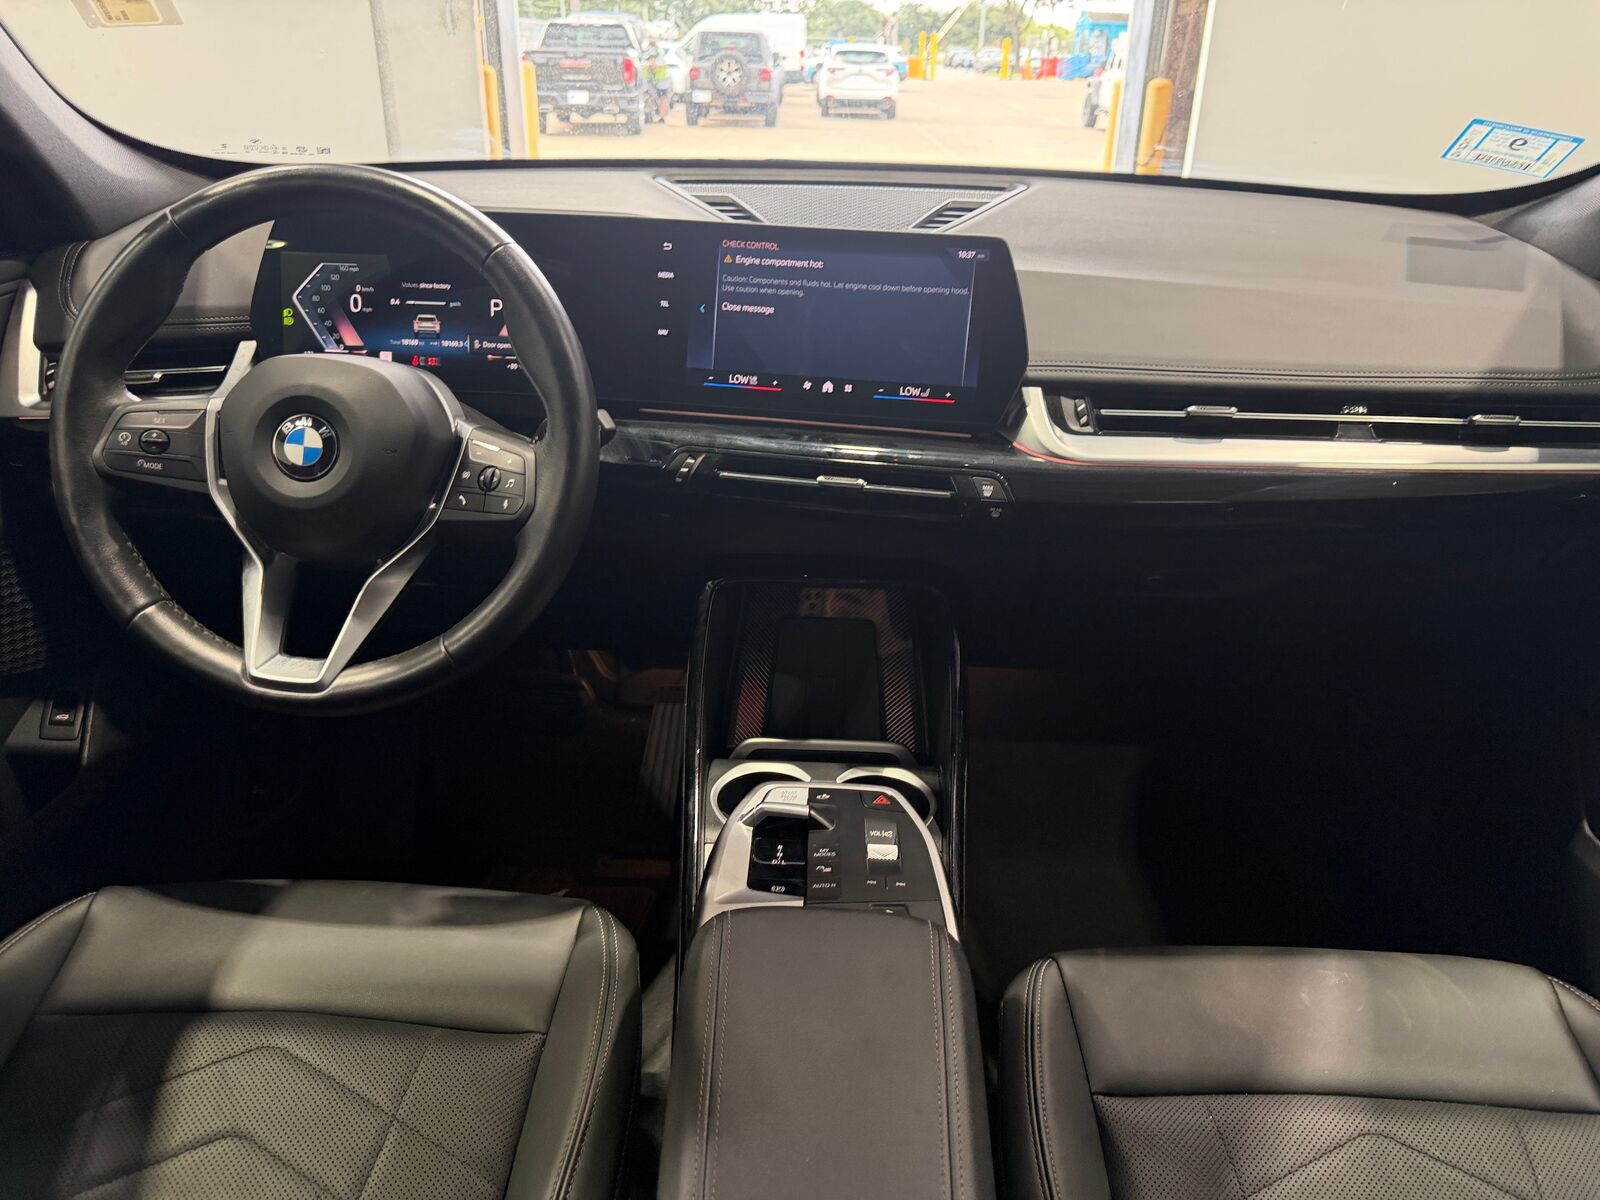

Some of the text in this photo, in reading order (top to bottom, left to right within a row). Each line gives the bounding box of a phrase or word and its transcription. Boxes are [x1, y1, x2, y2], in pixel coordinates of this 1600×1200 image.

[722, 240, 780, 250] CHECK CONTROL
[957, 250, 977, 259] 10:37
[735, 255, 761, 266] Engine
[761, 258, 809, 268] compartment
[355, 284, 361, 292] 0
[433, 282, 452, 291] factory
[722, 274, 748, 282] Caution:
[749, 275, 788, 285] Components
[802, 279, 819, 288] fluids
[833, 281, 844, 289] Let
[845, 282, 867, 291] engine
[868, 283, 882, 291] cool
[882, 284, 900, 292] down
[901, 285, 922, 293] before
[923, 286, 950, 296] opening
[951, 286, 970, 295] hood.
[722, 284, 735, 292] Use
[736, 285, 759, 293] caution
[759, 286, 777, 294] when
[349, 293, 362, 313] 0
[490, 298, 503, 317] P
[721, 301, 775, 315] Close message
[482, 341, 496, 349] Door
[728, 373, 749, 385] LOW
[899, 385, 920, 397] LOW
[281, 416, 332, 439] BMW
[143, 461, 163, 470] MODE
